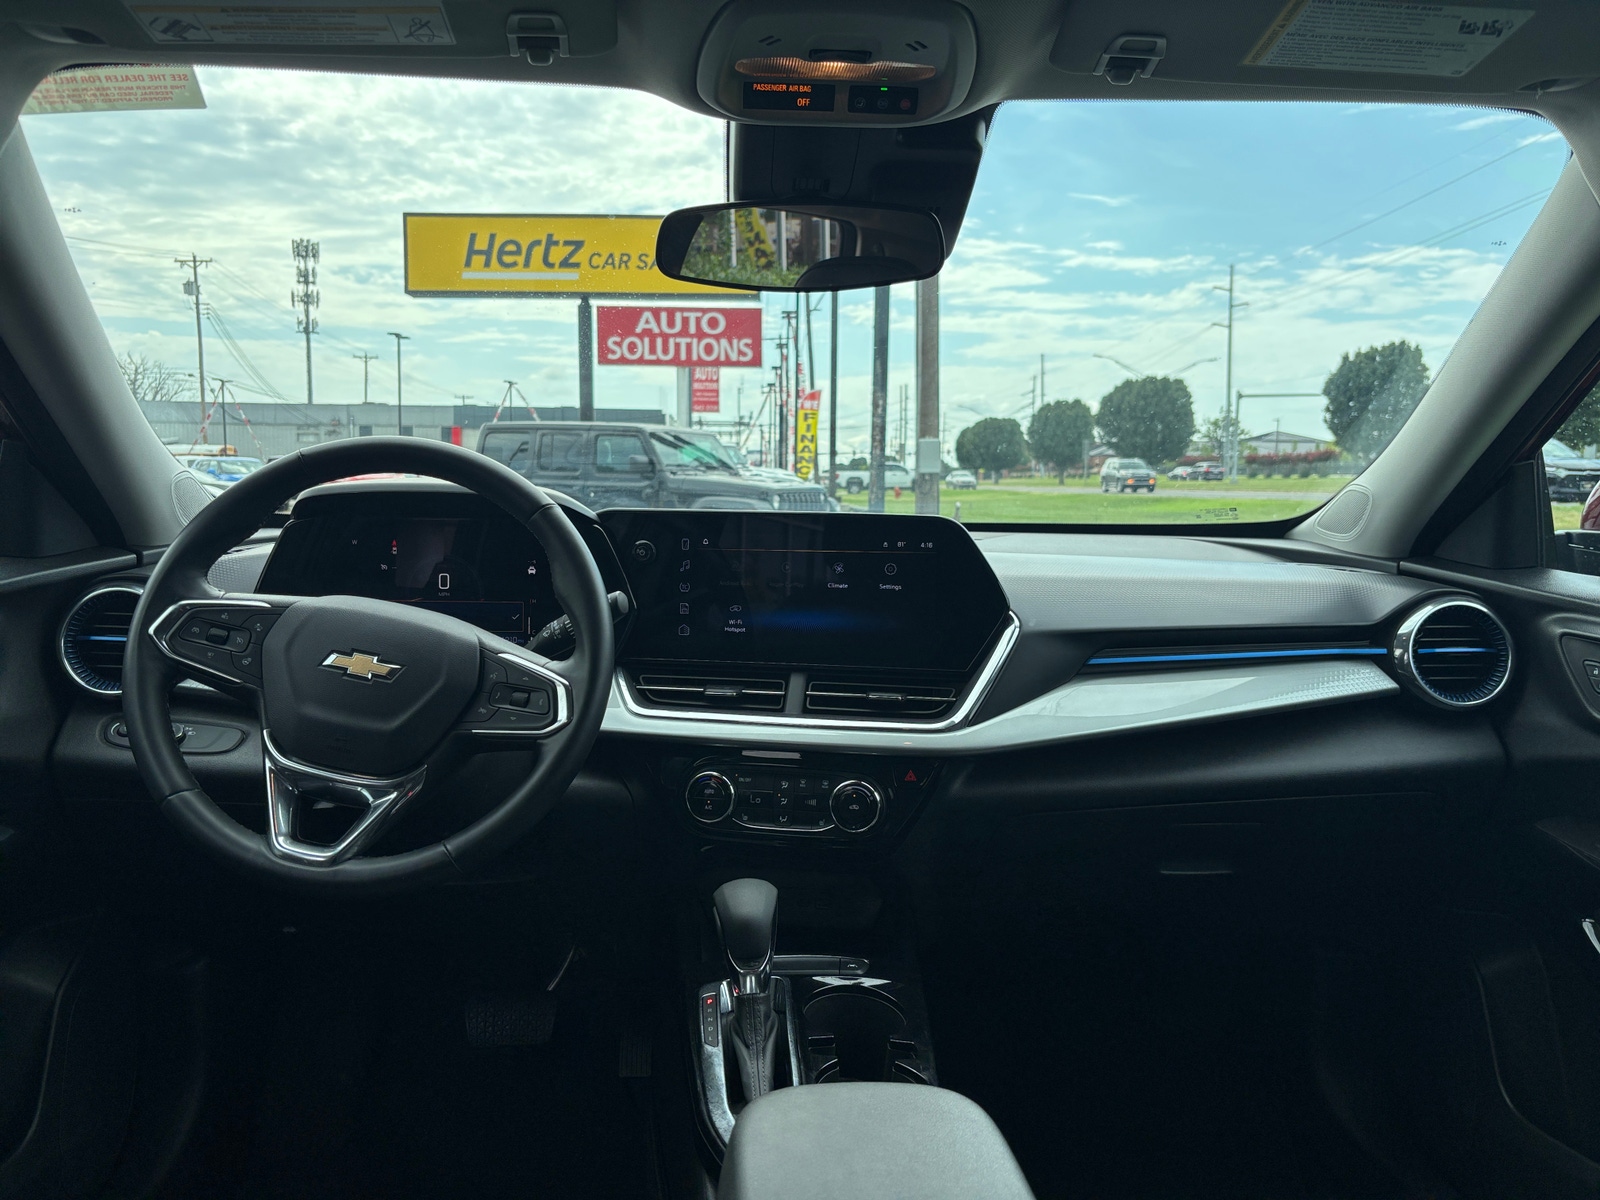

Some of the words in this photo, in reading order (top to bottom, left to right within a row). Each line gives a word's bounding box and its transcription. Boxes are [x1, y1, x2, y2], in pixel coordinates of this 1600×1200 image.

[753, 83, 787, 92] PASSENGER
[788, 84, 799, 92] AIR
[799, 85, 812, 93] BAG
[797, 98, 811, 107] OFF
[463, 232, 586, 269] Hertz
[588, 252, 631, 271] CAR
[634, 311, 727, 335] AUTO
[606, 336, 755, 362] SOLUTIONS
[438, 573, 450, 590] 0
[879, 583, 902, 591] Settings
[724, 626, 746, 634] Hotspot
